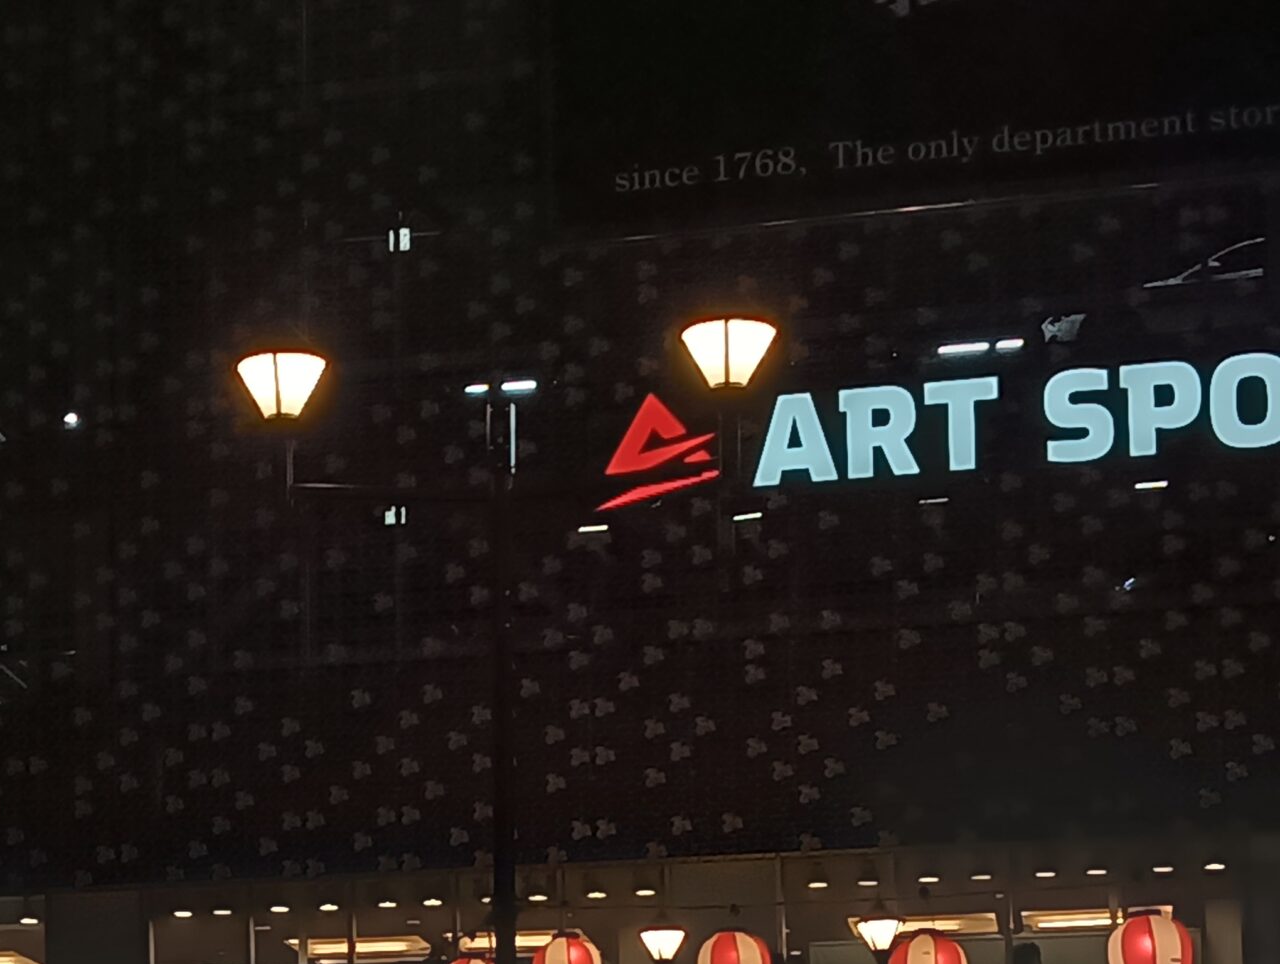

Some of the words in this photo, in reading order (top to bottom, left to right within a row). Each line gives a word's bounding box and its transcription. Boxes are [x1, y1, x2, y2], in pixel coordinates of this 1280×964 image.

[614, 162, 701, 193] since
[711, 146, 808, 182] 1768,
[827, 140, 897, 170] The
[907, 130, 980, 163] only
[991, 108, 1199, 155] department
[751, 374, 1001, 489] ART
[1041, 351, 1280, 464] SPO
